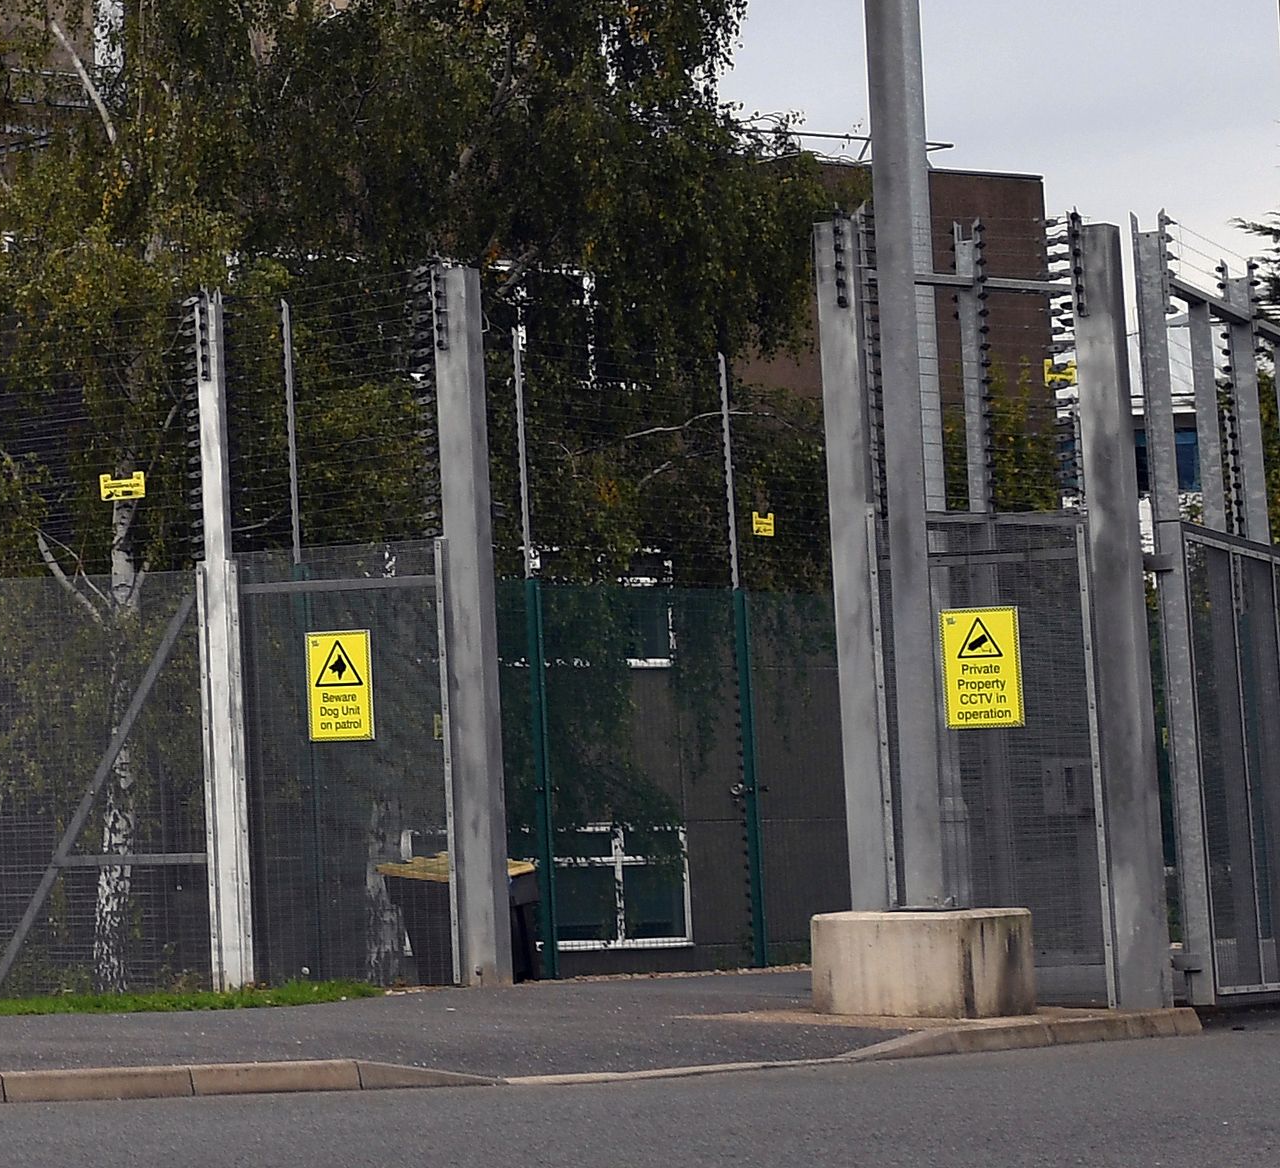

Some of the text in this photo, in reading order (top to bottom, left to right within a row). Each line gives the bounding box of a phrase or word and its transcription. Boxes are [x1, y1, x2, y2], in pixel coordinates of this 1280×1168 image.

[962, 664, 1000, 675] Private
[958, 679, 1006, 691] Property
[322, 693, 356, 702] Beware
[960, 693, 1006, 705] CCTV in
[320, 706, 360, 718] Dog Unit
[958, 708, 1011, 722] operation
[321, 719, 362, 731] on patrol
